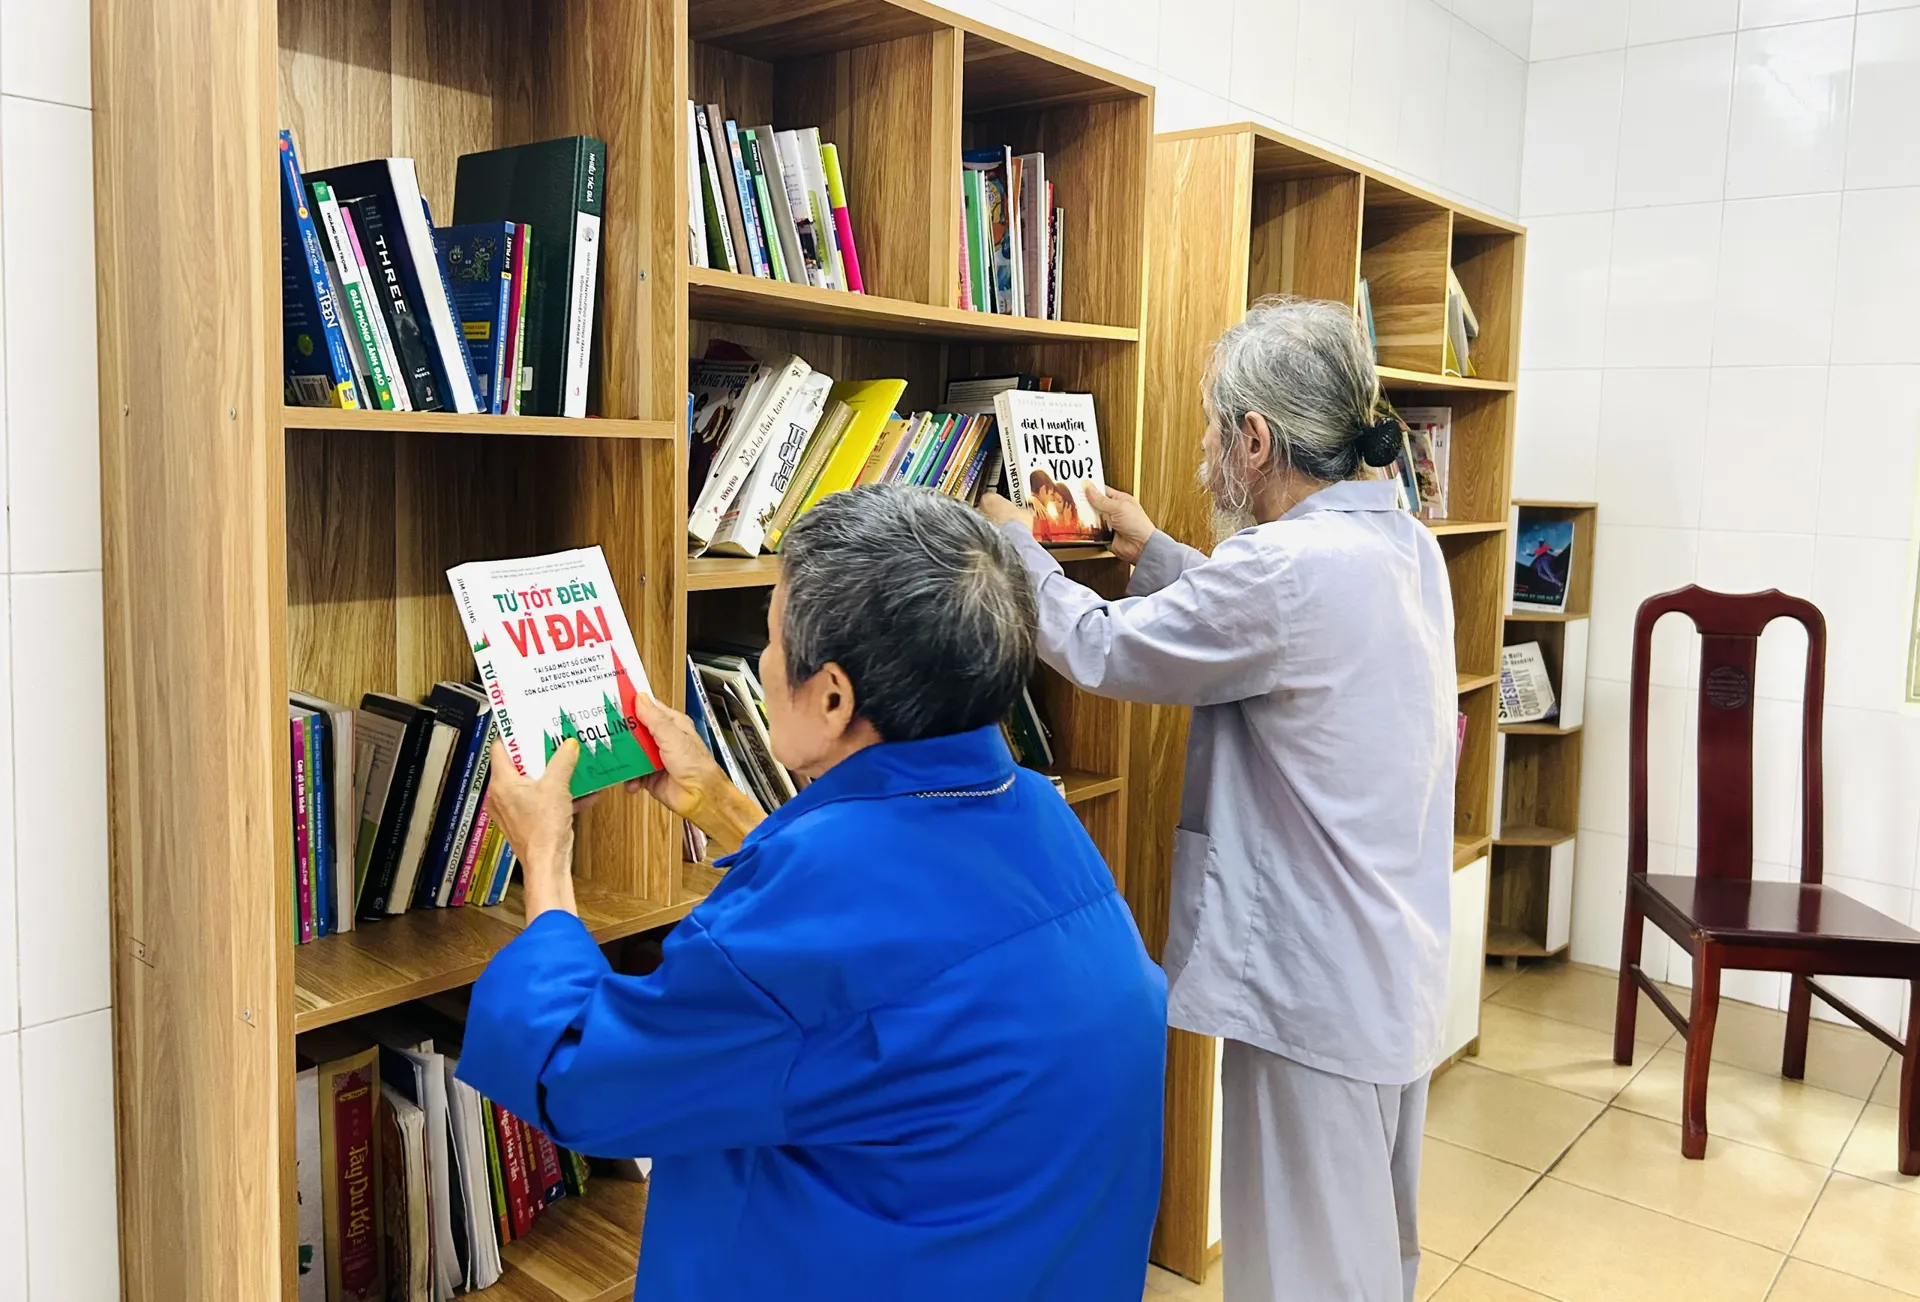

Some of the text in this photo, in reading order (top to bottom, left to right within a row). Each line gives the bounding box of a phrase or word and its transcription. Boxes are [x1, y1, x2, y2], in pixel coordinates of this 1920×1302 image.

[735, 160, 752, 223] SUPER HAPPY PARTY BEARS
[375, 234, 407, 315] THREE
[317, 291, 337, 329] TEEN
[350, 289, 385, 387] GIẢI PHÓNG LÃNH ĐẠO
[1020, 417, 1087, 432] did I mention
[1023, 433, 1075, 455] I NEED
[1009, 467, 1020, 489] NEED
[1048, 457, 1093, 481] YOU?
[1013, 488, 1023, 508] YOU?
[456, 577, 477, 624] JIM COLLINS
[492, 576, 598, 613] TỪ TỐT ĐẾN
[501, 605, 613, 658] VĨ ĐẠI
[482, 660, 498, 681] TỪ
[579, 656, 597, 665] CÔNG
[488, 679, 505, 707] TỐT
[550, 682, 567, 691] CÔNG
[1500, 671, 1520, 706] DESIGN
[1512, 669, 1541, 716] COMPANY
[496, 707, 514, 739] ĐẾN
[552, 701, 618, 727] GOOD TO GREAT
[576, 716, 638, 744] COLLINS
[486, 720, 499, 745] BODY
[471, 744, 492, 791] LANGUAGE
[457, 819, 469, 843] NGÔN
[466, 827, 483, 865] NORTHERN
[459, 865, 471, 884] ROCK
[344, 1139, 369, 1180] Tây
[537, 1136, 558, 1178] SECRET
[345, 1174, 368, 1207] Du
[345, 1205, 371, 1239] Ký
